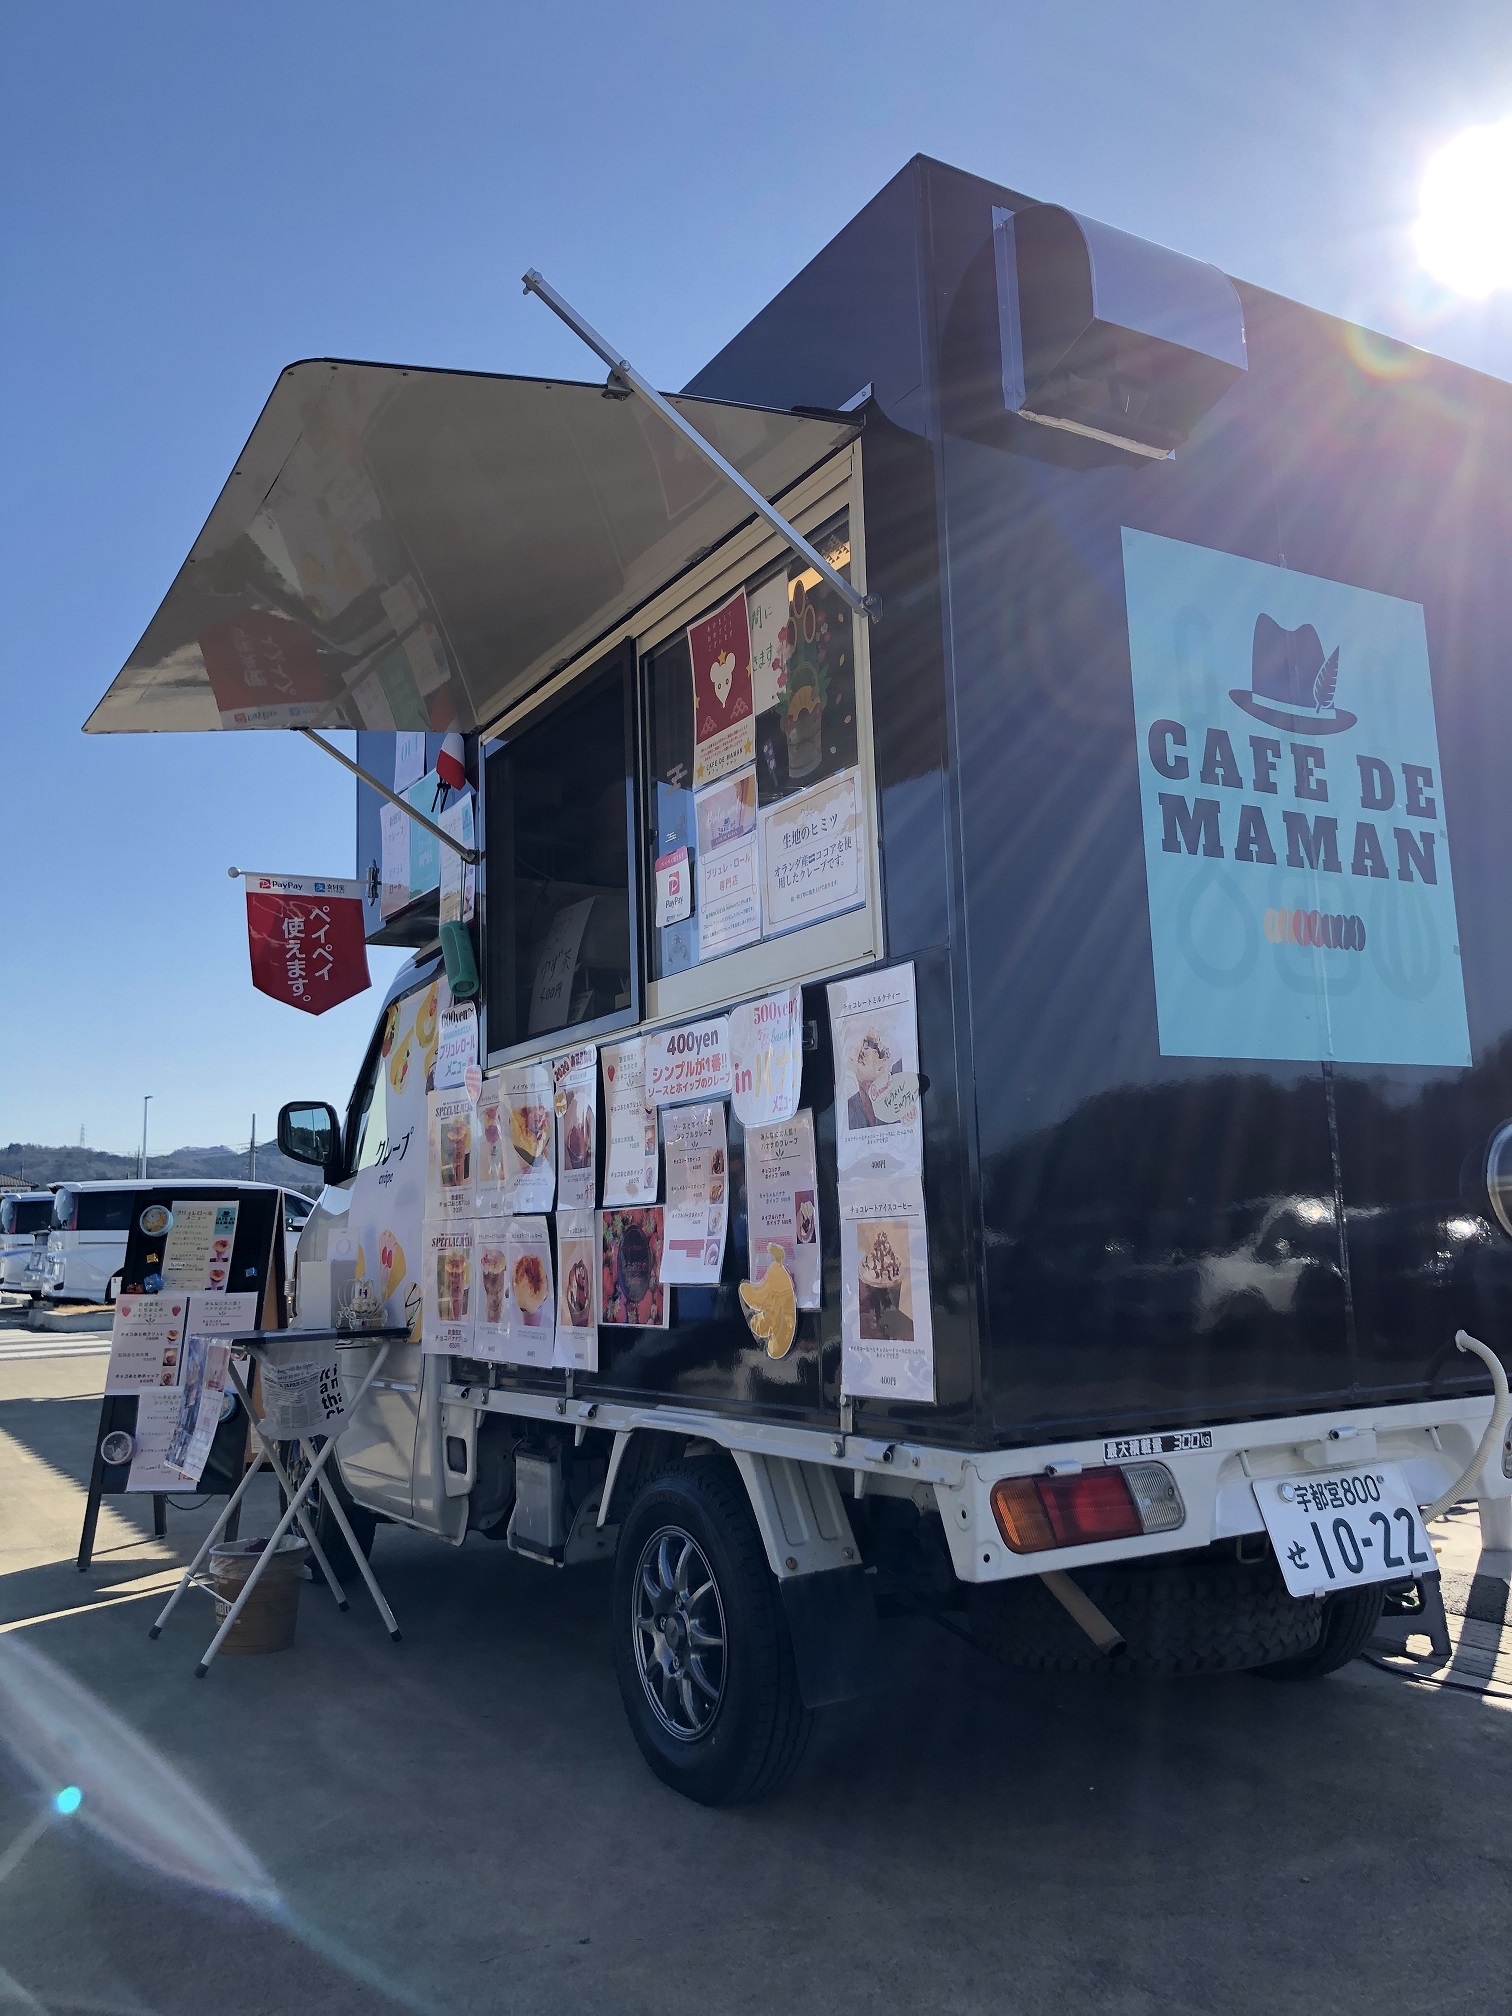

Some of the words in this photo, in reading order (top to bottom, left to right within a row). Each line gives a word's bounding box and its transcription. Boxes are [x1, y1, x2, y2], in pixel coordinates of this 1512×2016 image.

[1148, 719, 1328, 802] CAFE
[1356, 754, 1437, 819] DE
[783, 813, 838, 849] 生地のヒミツ
[1158, 792, 1438, 885] MAMAN
[272, 881, 303, 890] PayPay
[665, 894, 684, 909] PayPay
[310, 905, 335, 981] ペイペイ
[282, 917, 312, 1002] 使えます。
[667, 1029, 719, 1056] 400yen
[554, 1060, 570, 1082] 2020
[648, 1071, 731, 1098] ソースとホイップのクレープ
[734, 1062, 753, 1094] in
[375, 1126, 415, 1166] クレープ
[850, 1203, 912, 1214] チョコレートアイスコーヒー
[1106, 1437, 1164, 1459] 最大積載量
[1174, 1431, 1211, 1451] 300kg
[1294, 1480, 1345, 1513] 宇都宮
[1287, 1540, 1310, 1569] せ
[1310, 1507, 1429, 1579] 10-22
